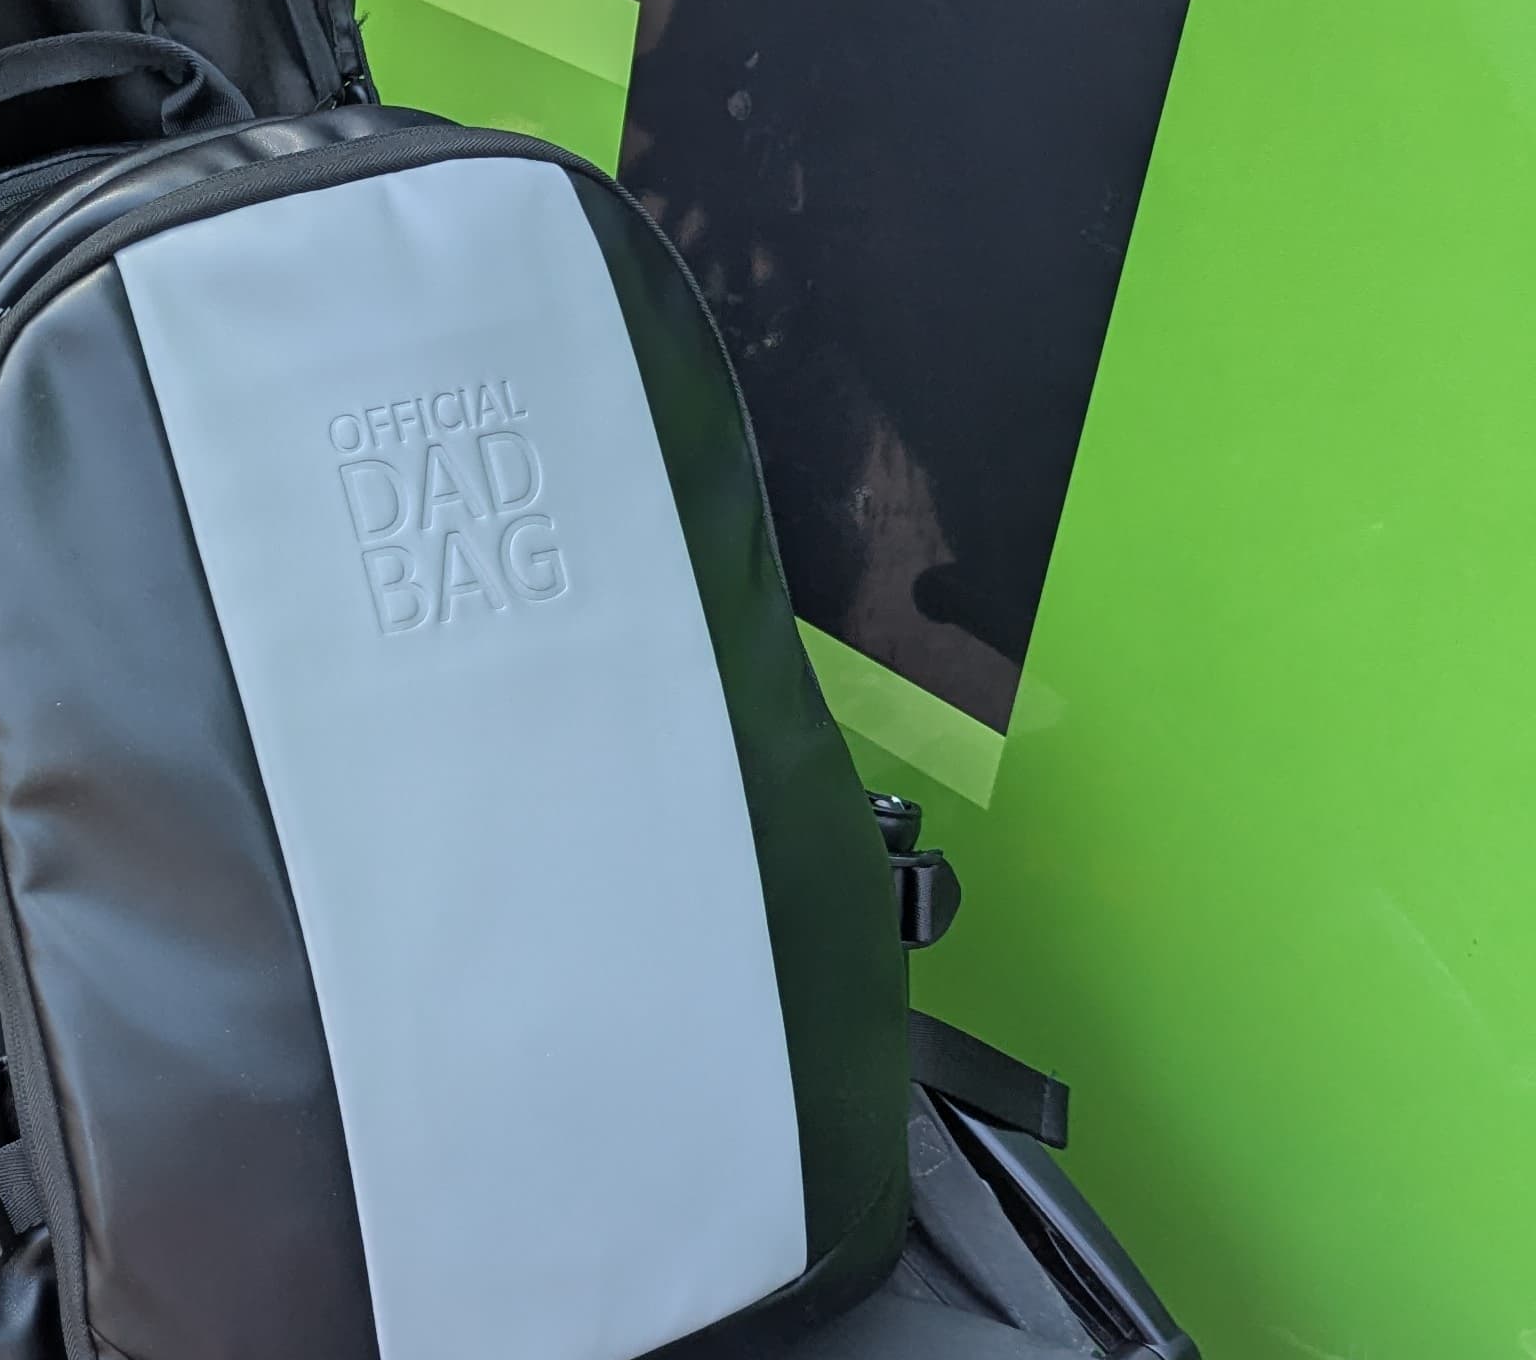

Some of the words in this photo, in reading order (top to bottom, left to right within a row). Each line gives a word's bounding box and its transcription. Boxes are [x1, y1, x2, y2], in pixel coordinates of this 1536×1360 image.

[328, 380, 529, 454] OFFICIAL
[338, 430, 543, 543] DAD
[361, 513, 569, 636] BAG
